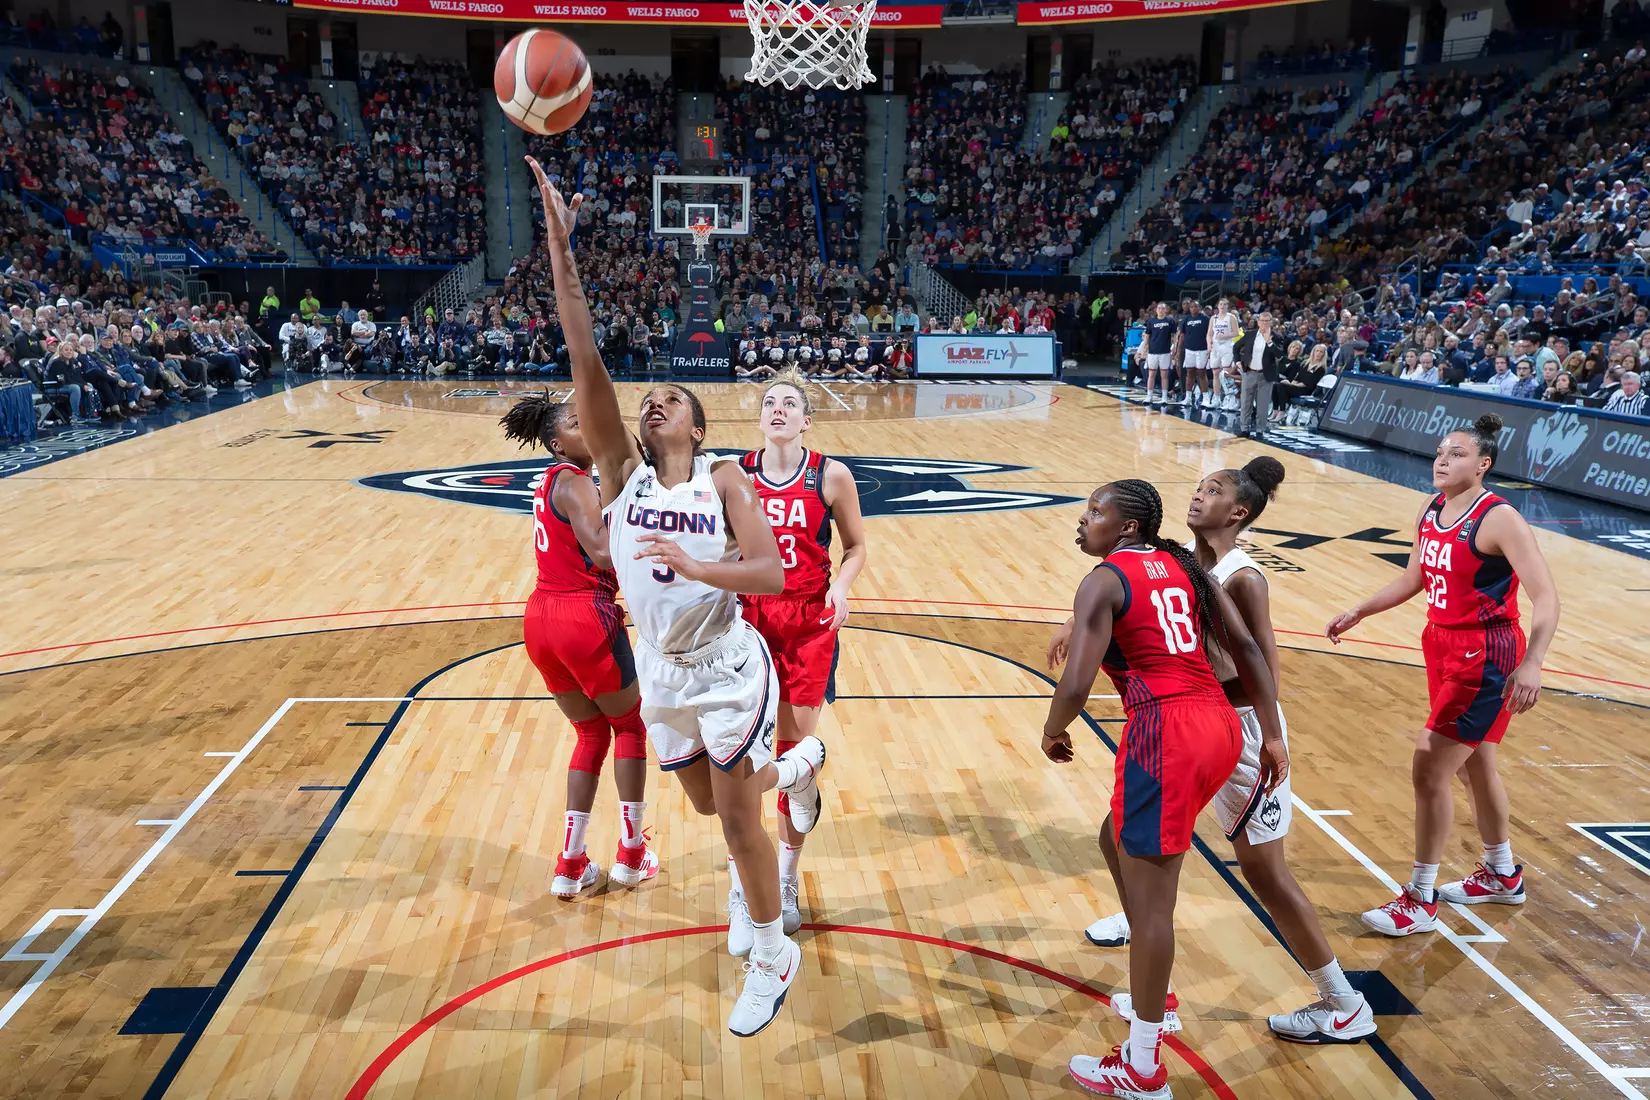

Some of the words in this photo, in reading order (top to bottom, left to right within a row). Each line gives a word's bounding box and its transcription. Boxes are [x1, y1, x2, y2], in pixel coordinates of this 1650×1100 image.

[429, 0, 466, 12] WELLS
[468, 2, 504, 14] FARGO
[534, 5, 569, 16] WELLS
[571, 5, 607, 16] FARGO
[627, 7, 663, 18] WELLS
[665, 8, 700, 18] FARGO
[1040, 7, 1075, 17] WELLS
[1077, 4, 1113, 15] FARGO
[872, 11, 903, 22] ARGO
[697, 126, 717, 138] 1:31
[947, 347, 985, 360] LAZ
[986, 349, 1009, 361] FLY
[672, 356, 730, 368] TRAVELERS
[626, 503, 716, 536] UCONN
[760, 498, 807, 528] SA
[1419, 536, 1453, 572] USA
[1142, 560, 1170, 580] GRAY
[1425, 570, 1448, 610] 32
[1150, 587, 1198, 655] 18
